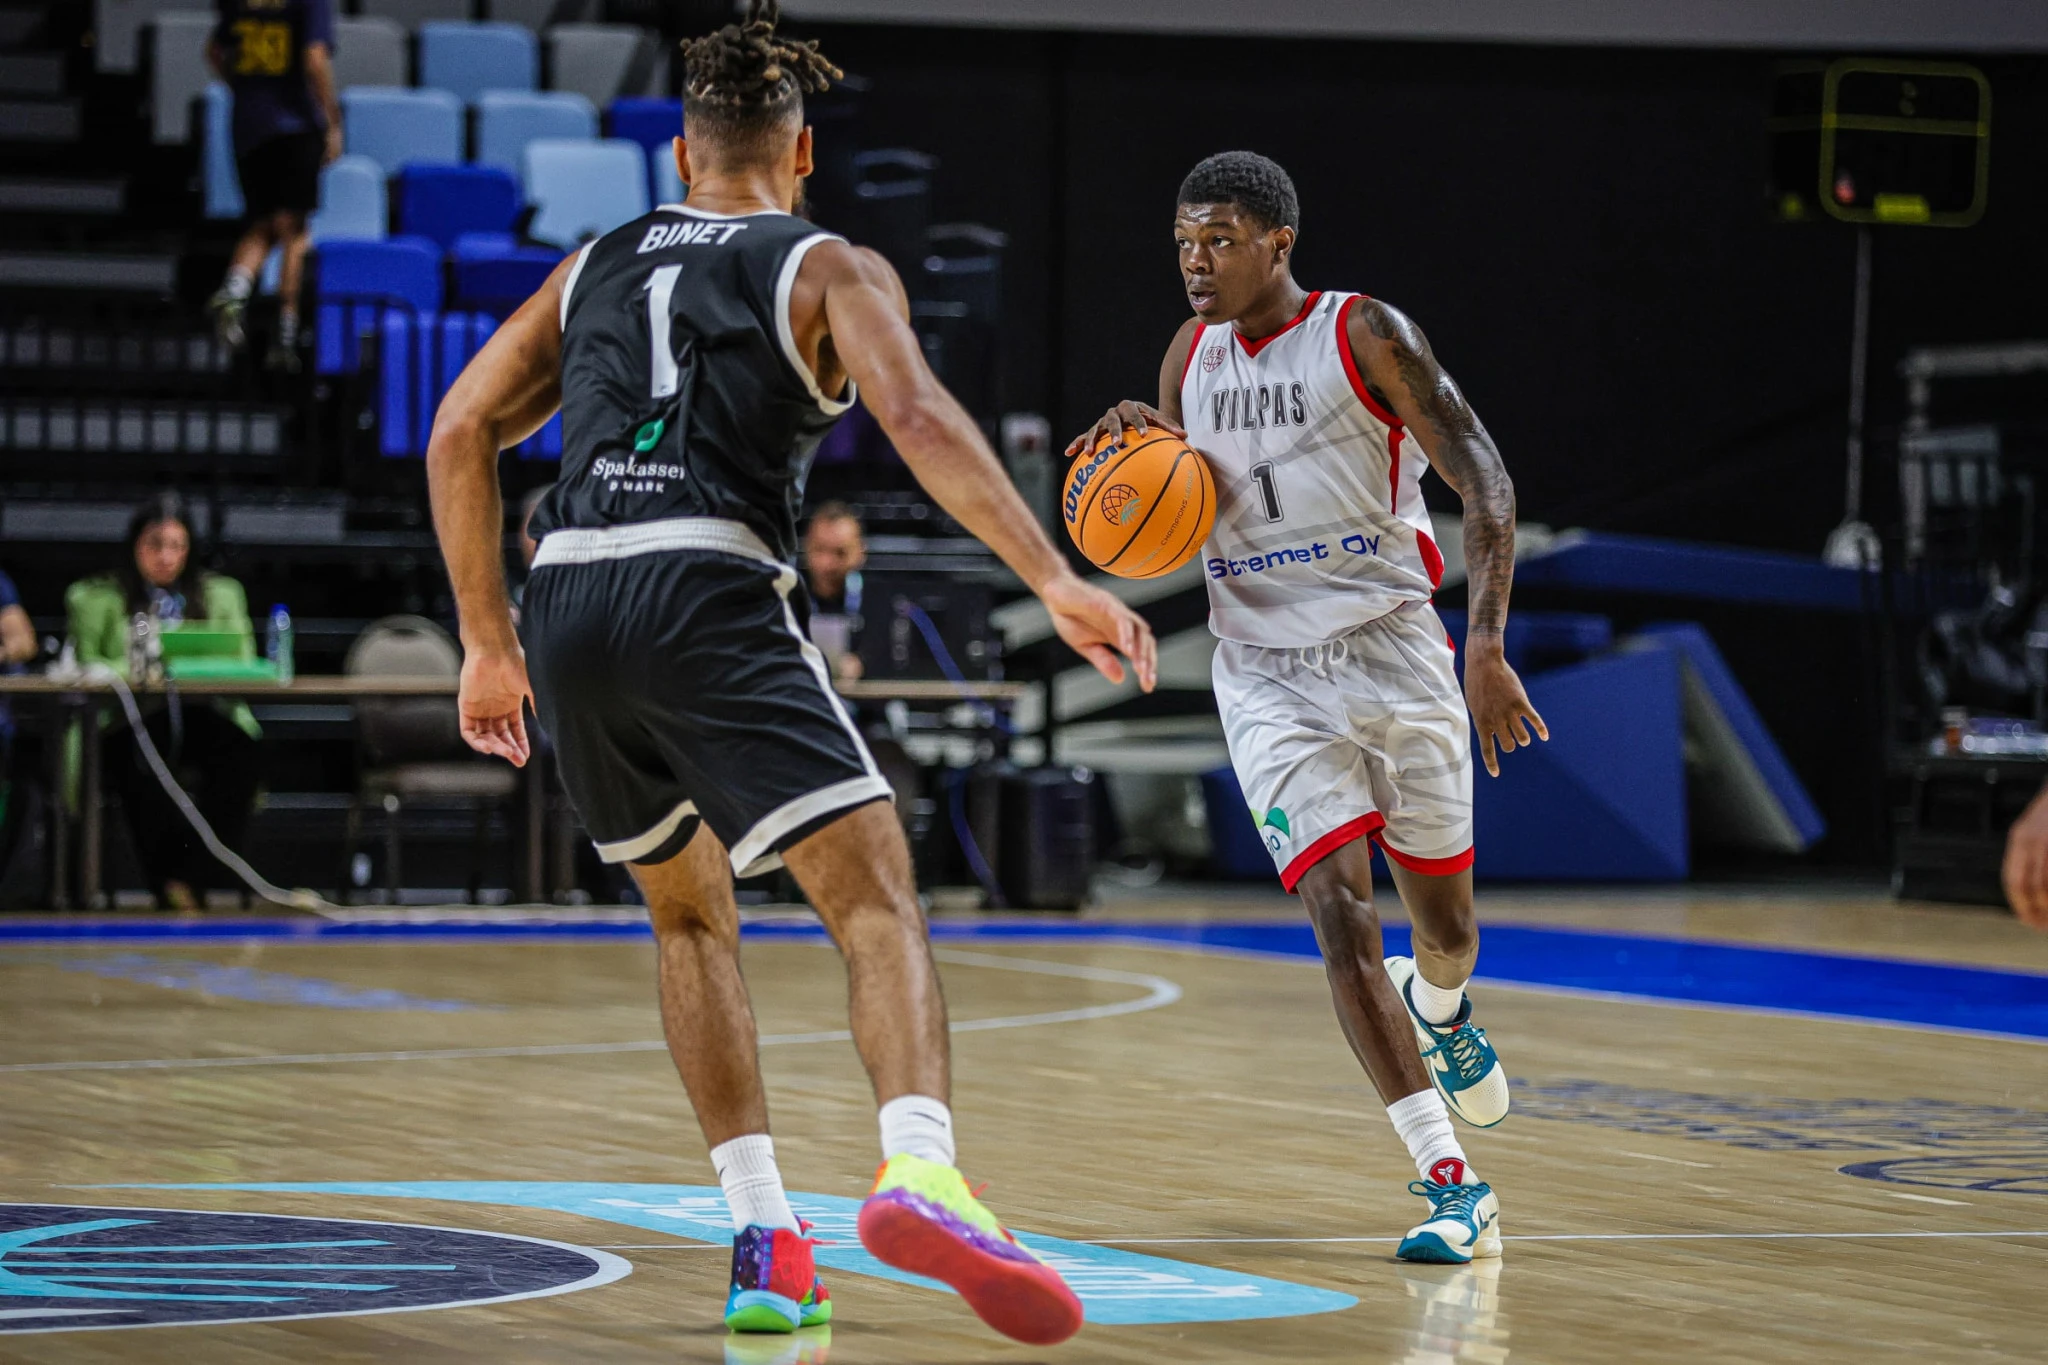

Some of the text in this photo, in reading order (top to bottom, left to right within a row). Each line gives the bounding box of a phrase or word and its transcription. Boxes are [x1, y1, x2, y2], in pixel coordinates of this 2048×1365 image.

[637, 222, 748, 254] BINET
[643, 264, 683, 398] 1
[1211, 381, 1308, 433] VILPAS
[1250, 461, 1284, 523] 1
[1161, 498, 1188, 546] CHAMPIONS
[1207, 541, 1329, 580] Stremet
[1341, 534, 1380, 555] Oy
